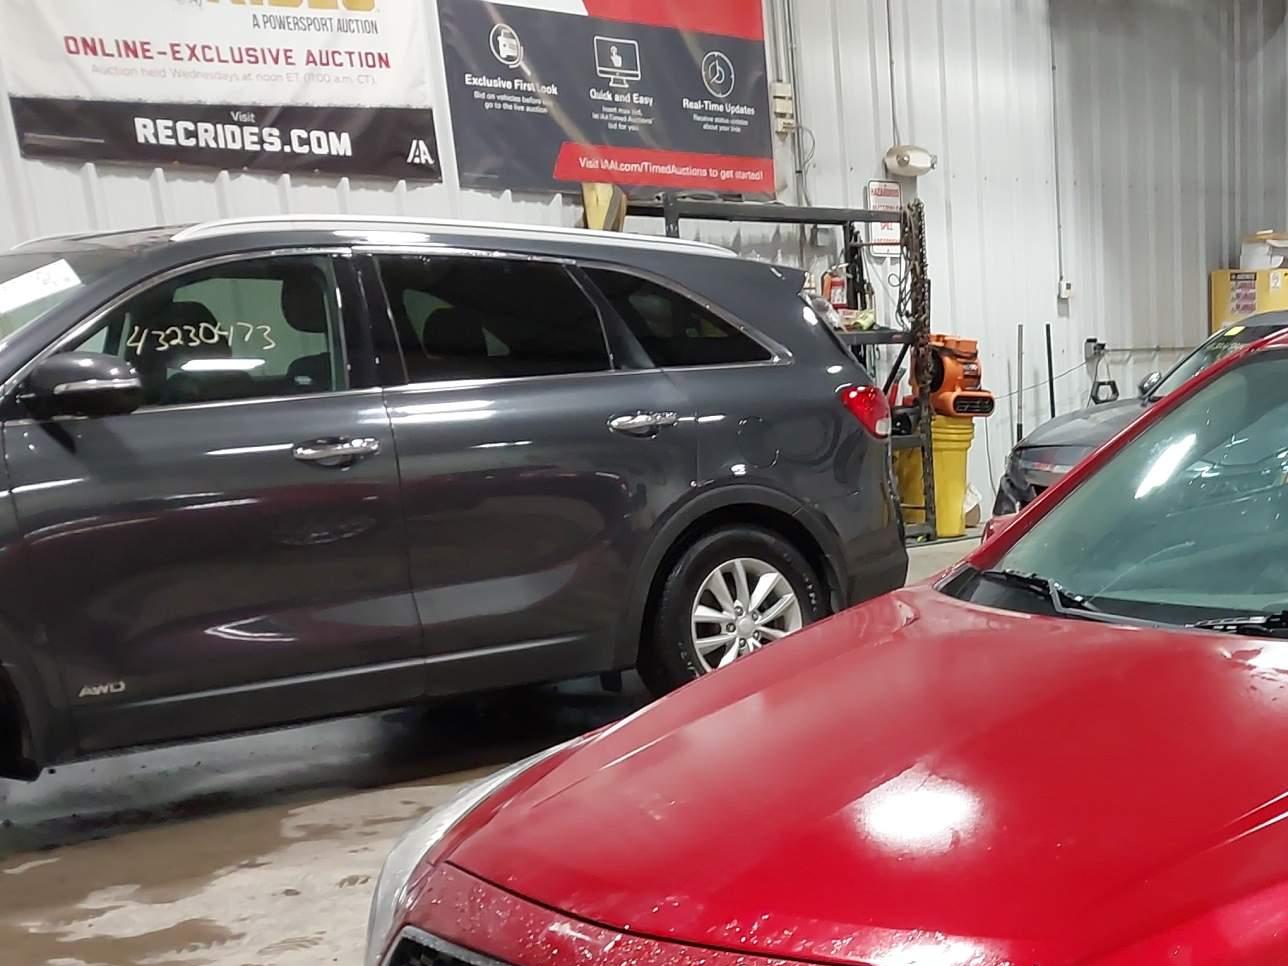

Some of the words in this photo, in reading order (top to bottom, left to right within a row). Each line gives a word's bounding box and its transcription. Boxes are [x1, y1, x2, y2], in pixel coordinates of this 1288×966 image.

[251, 14, 261, 30] A
[263, 14, 335, 34] POWERSPORT
[337, 18, 379, 35] AUCTION
[64, 36, 296, 66] ONLINE-EXCLUSIVE
[305, 50, 391, 69] AUCTION
[464, 73, 513, 90] Exclusive
[589, 88, 613, 101] Quick
[614, 92, 631, 103] and
[632, 92, 654, 107] Easy
[682, 98, 724, 112] Real-Time
[725, 102, 755, 115] Updates
[230, 110, 256, 123] Visit
[133, 117, 353, 157] RECRIDES.COM
[578, 156, 599, 169] Visit
[708, 170, 719, 178] to
[719, 171, 734, 181] get
[126, 322, 277, 356] 43230473
[78, 680, 126, 698] AWD
